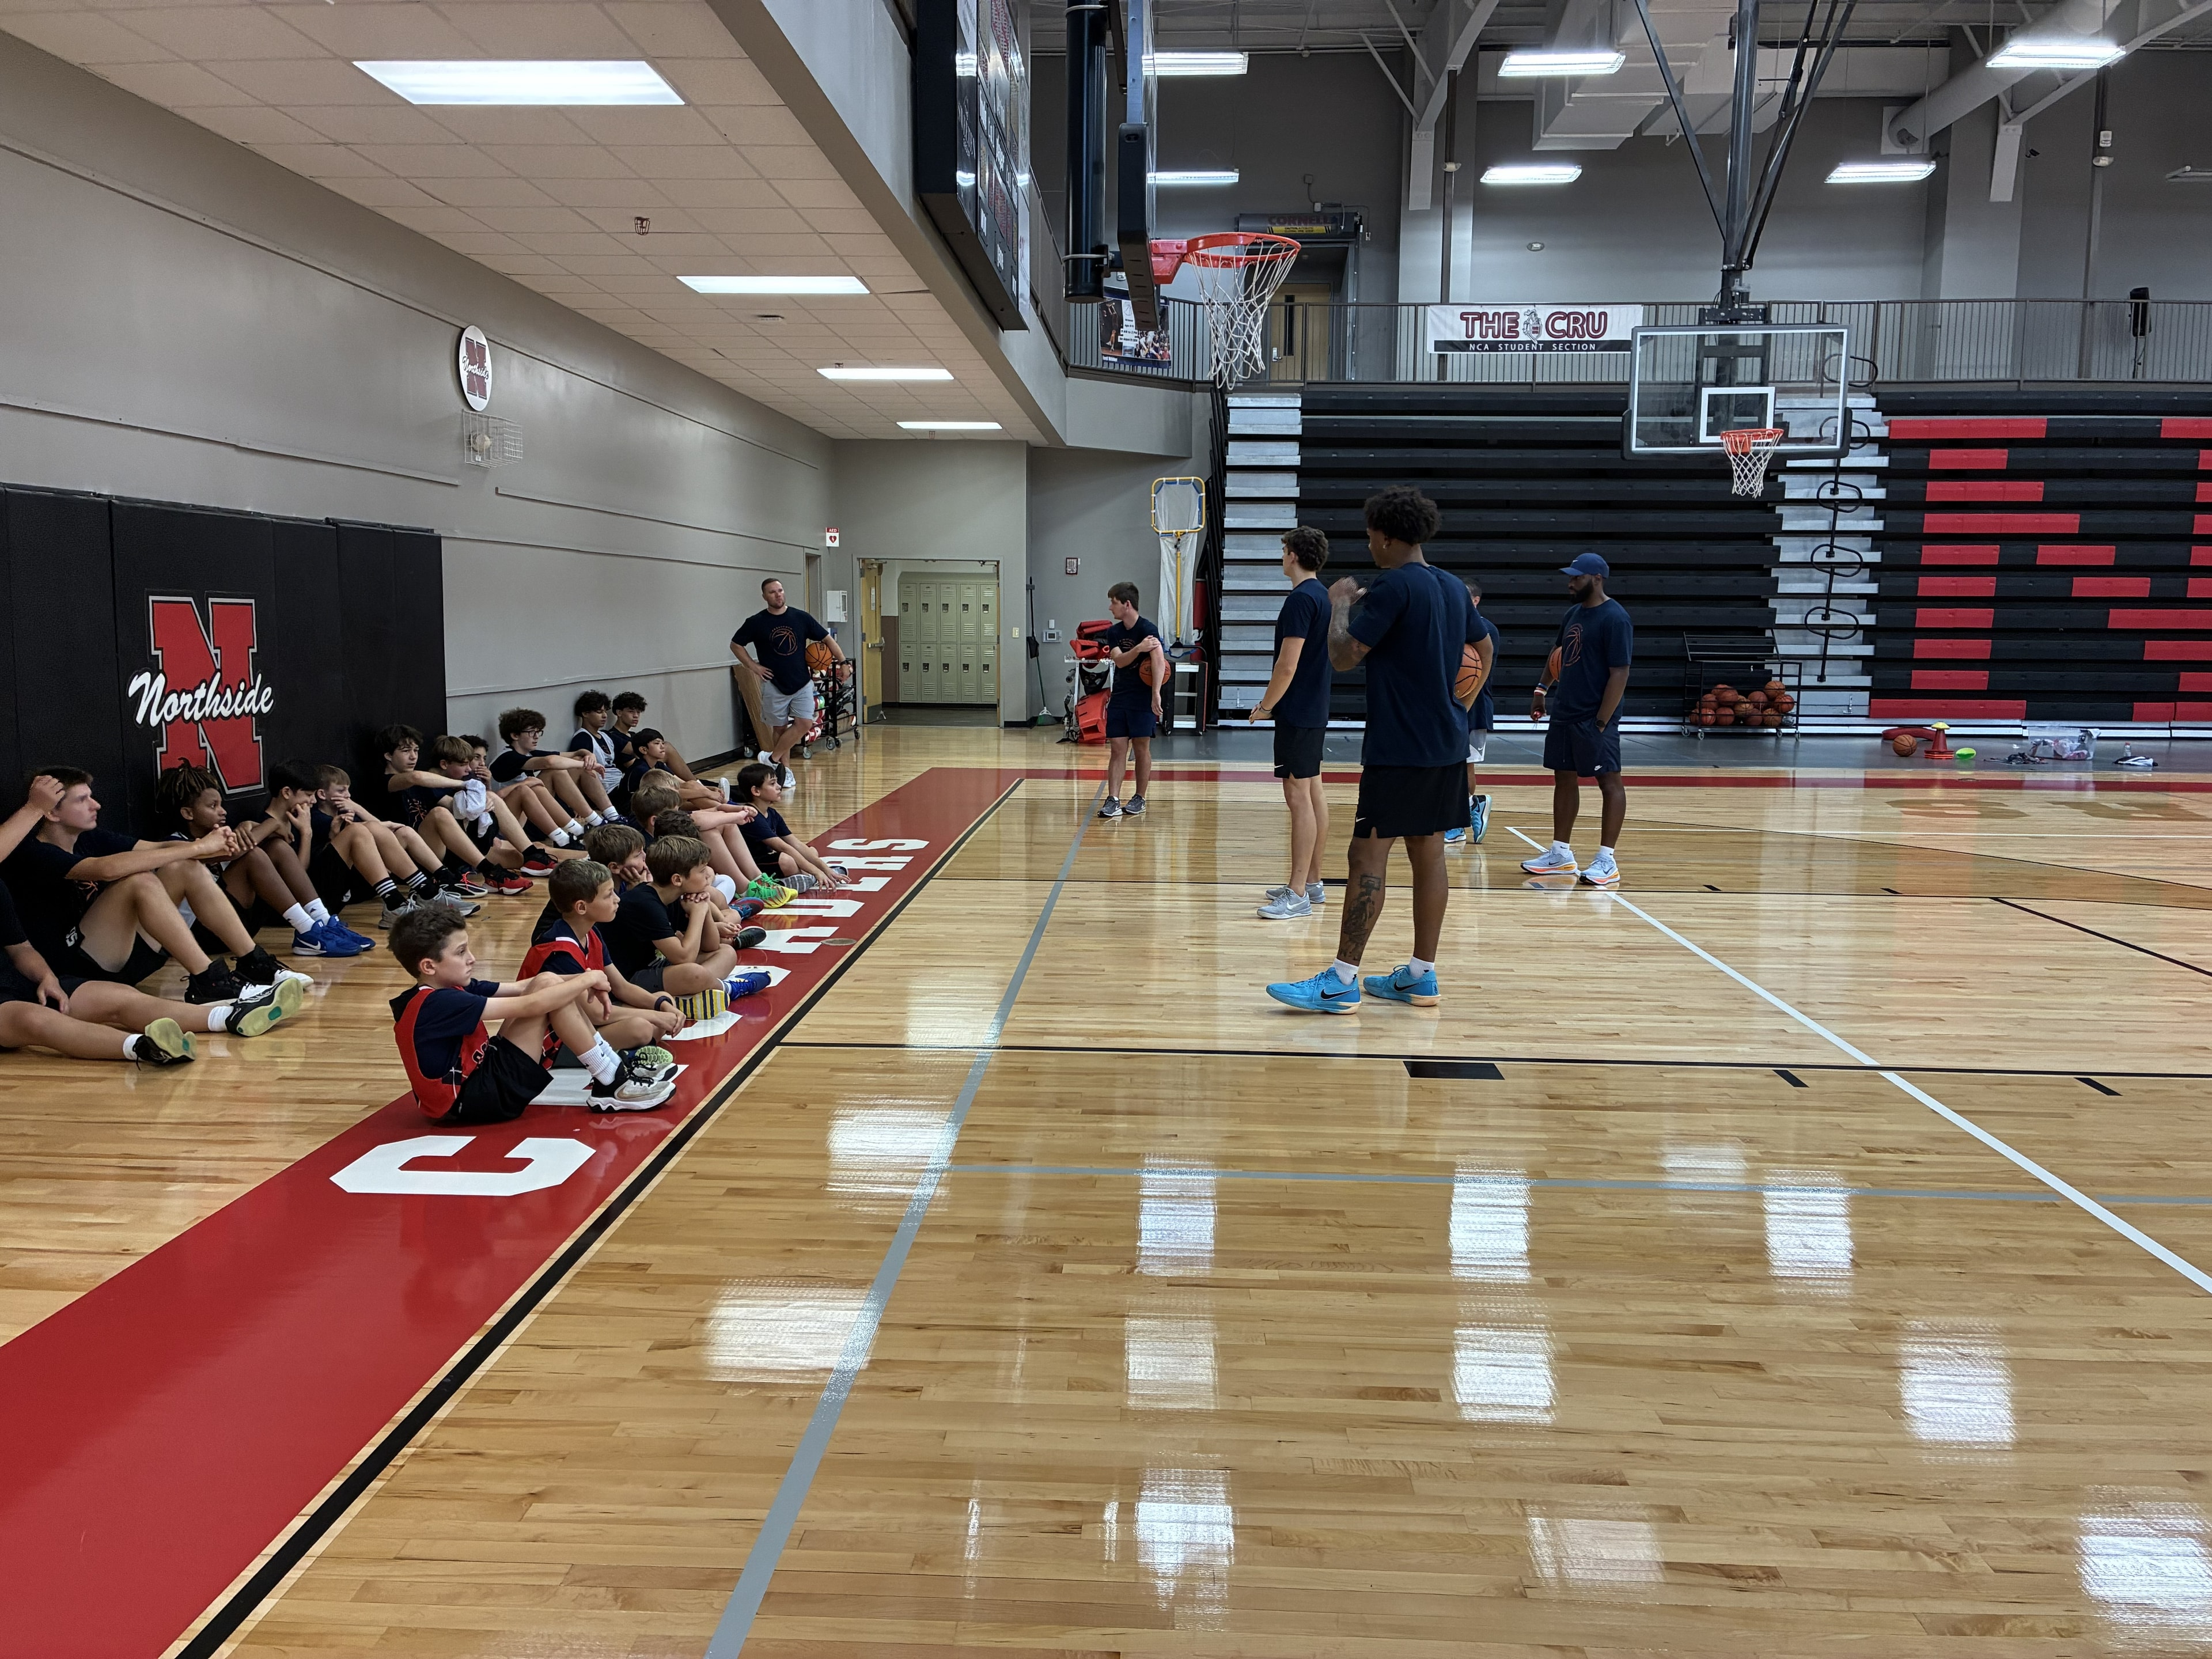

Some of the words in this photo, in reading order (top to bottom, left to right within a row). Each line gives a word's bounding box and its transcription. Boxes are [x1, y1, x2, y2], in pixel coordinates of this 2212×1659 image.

[1460, 312, 1520, 339] THE
[1546, 312, 1608, 339] CRU
[462, 356, 489, 380] Northside
[128, 671, 274, 727] Northside
[149, 595, 264, 795] N
